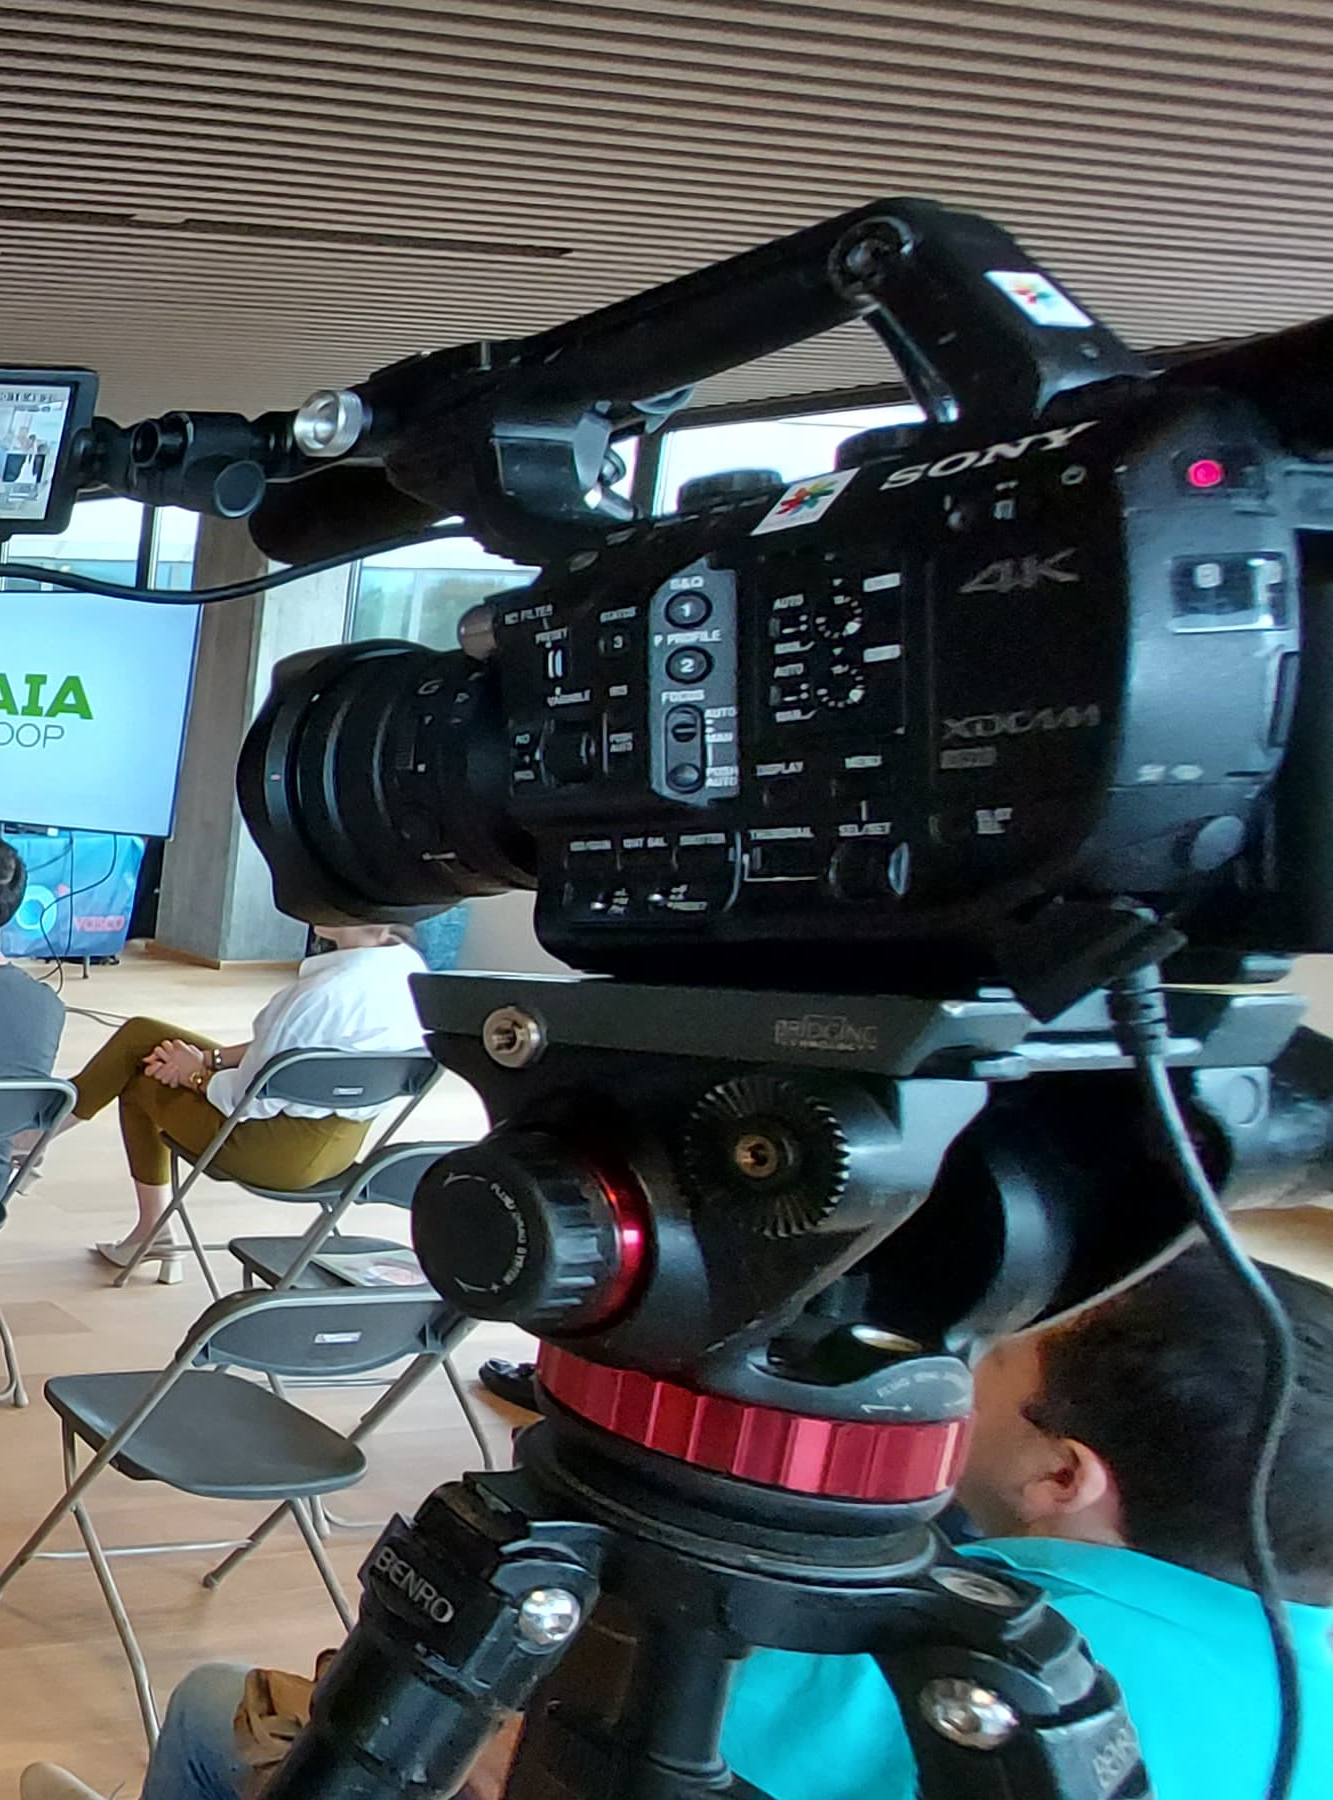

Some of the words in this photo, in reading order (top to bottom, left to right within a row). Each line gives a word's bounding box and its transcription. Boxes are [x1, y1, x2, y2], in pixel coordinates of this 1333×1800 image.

[879, 420, 1101, 491] SONY
[959, 547, 1080, 594] 4K
[681, 603, 692, 617] 1
[612, 636, 624, 649] 3
[666, 629, 723, 646] PROFILE
[679, 658, 695, 673] 2
[705, 707, 736, 718] AUTO
[374, 1545, 456, 1624] BENRO
